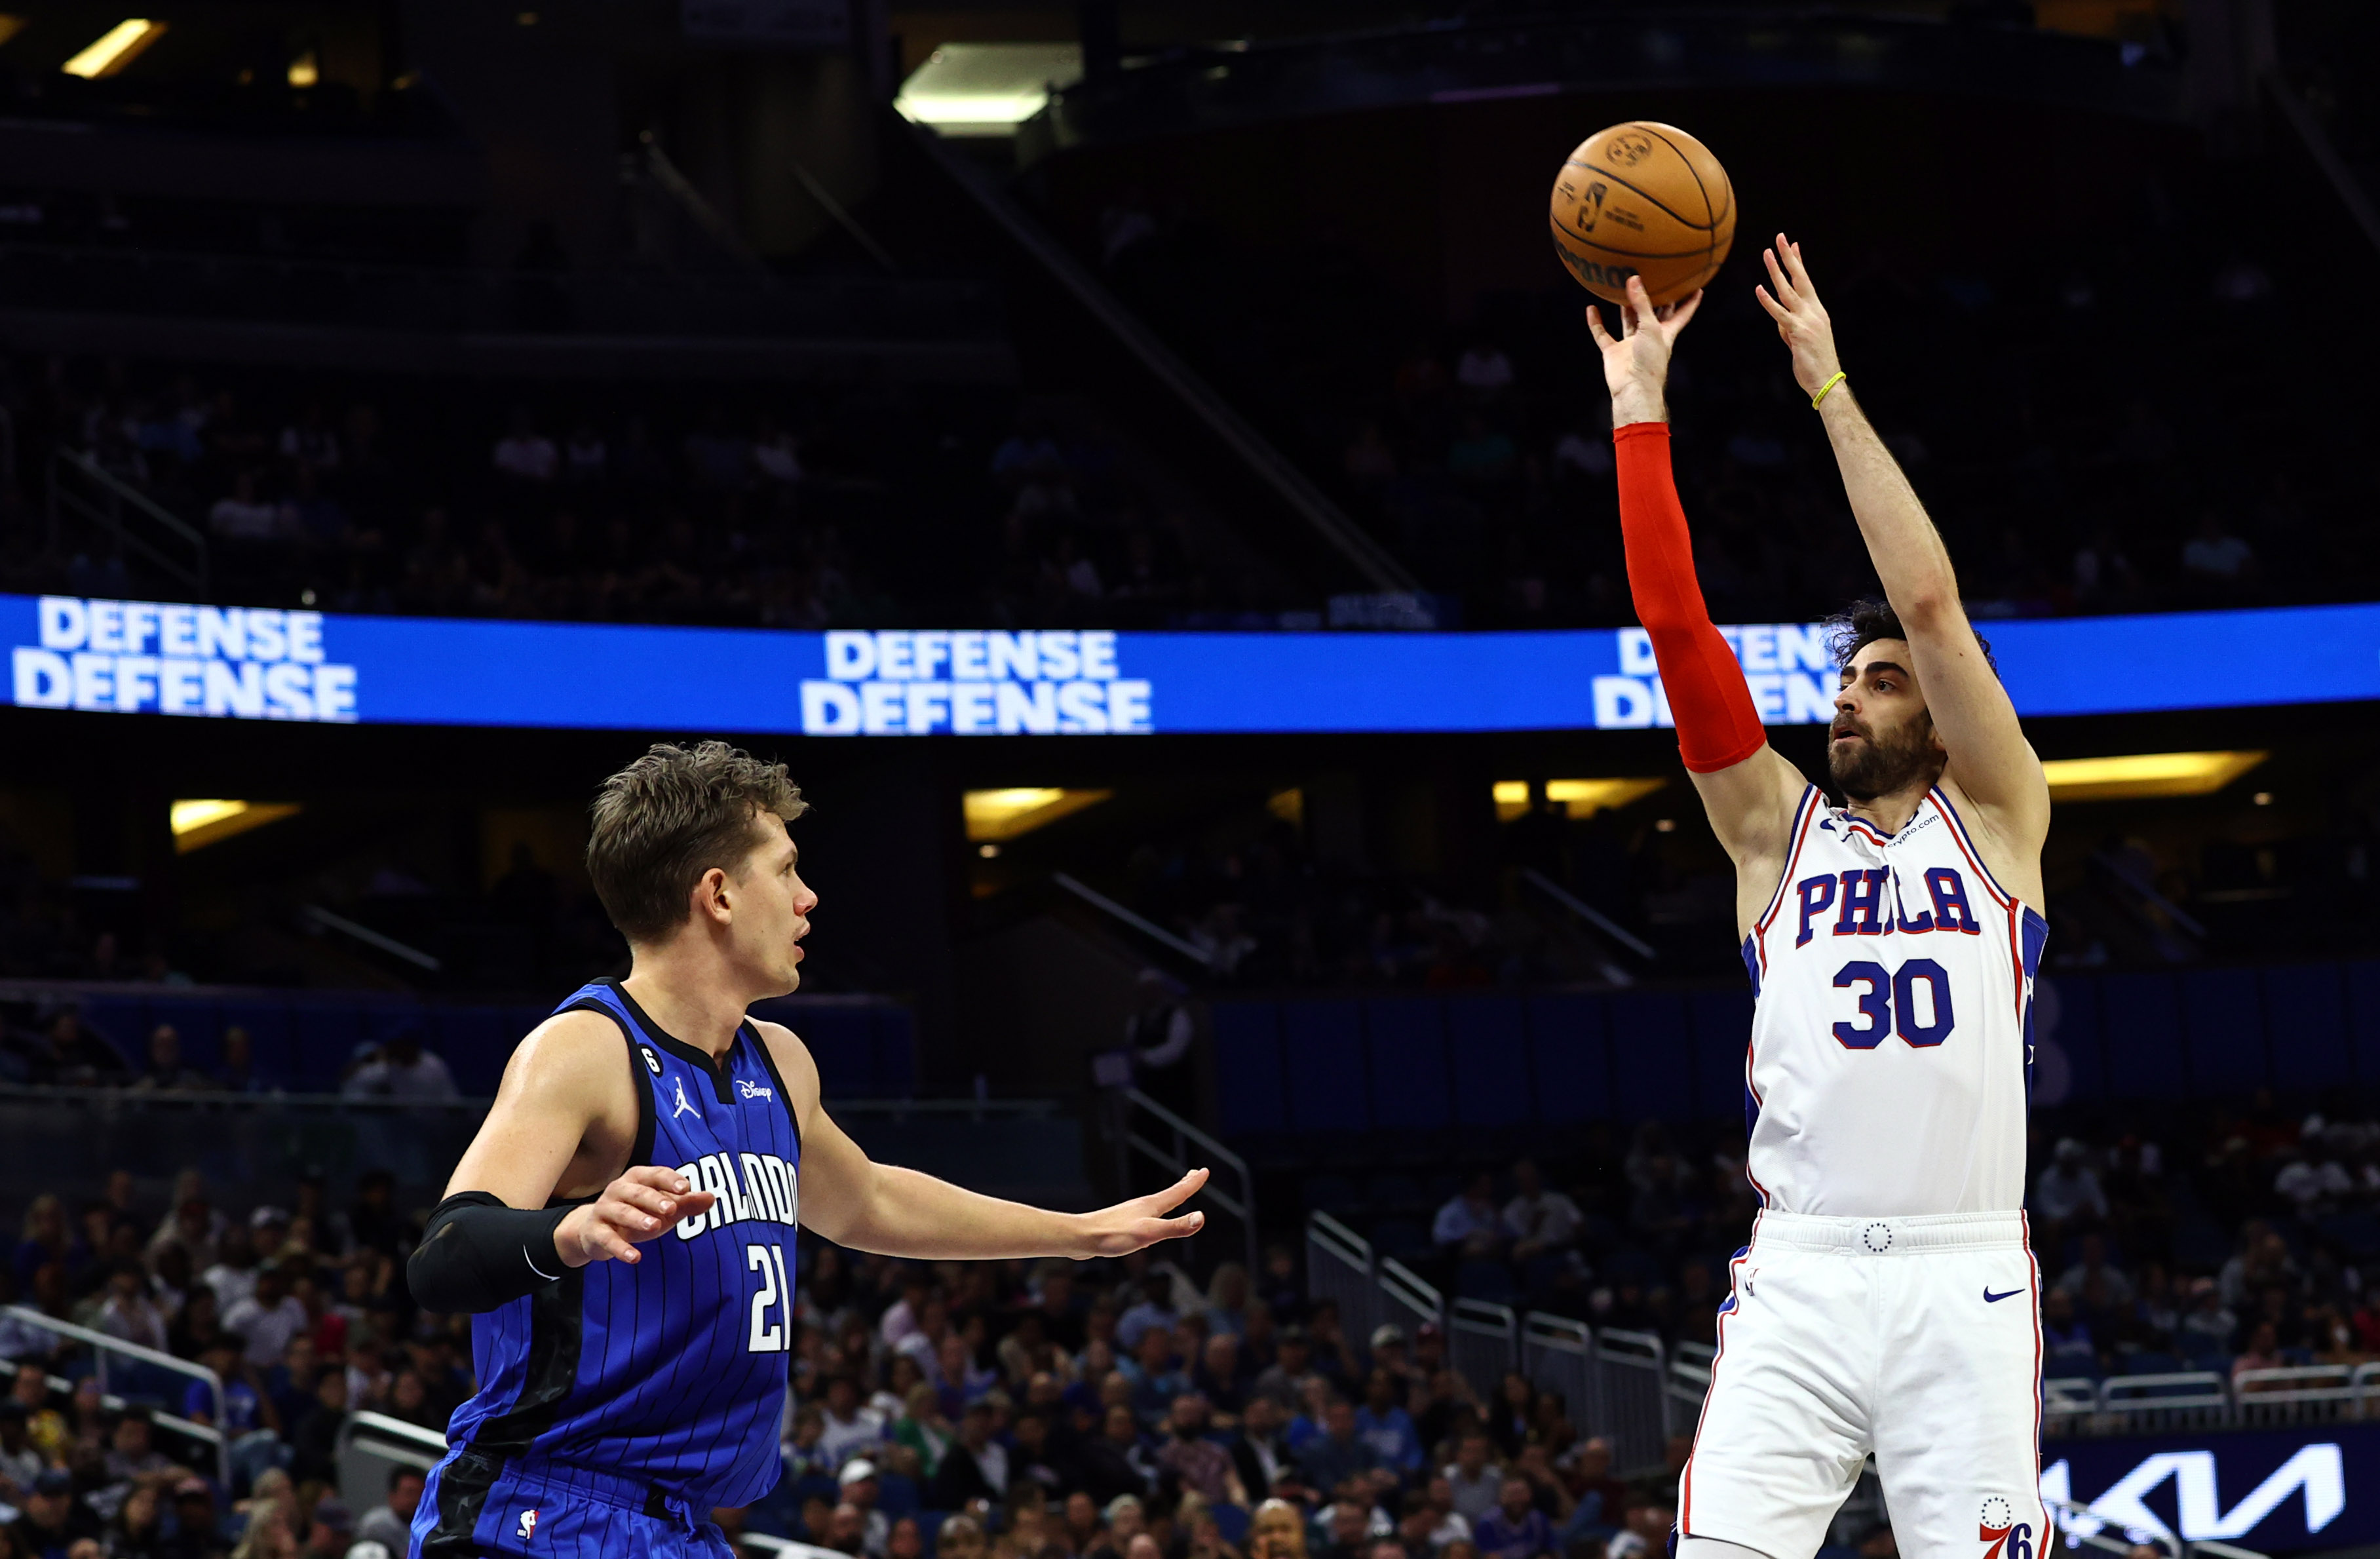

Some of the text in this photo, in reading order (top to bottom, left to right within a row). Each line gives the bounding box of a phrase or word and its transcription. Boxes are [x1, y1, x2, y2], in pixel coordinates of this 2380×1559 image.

[39, 594, 325, 663] DEFENSE
[825, 629, 1119, 680] DEFENSE
[12, 645, 358, 724] DEFENSE
[800, 678, 1154, 736] DEFENSE
[1887, 814, 1940, 848] crypto.com
[1833, 958, 1955, 1049] 30
[641, 1048, 661, 1073] 6
[735, 1080, 772, 1103] Disney
[675, 1151, 798, 1241] ORLNDO
[747, 1244, 791, 1353] 21
[1979, 1522, 2033, 1559] 76
